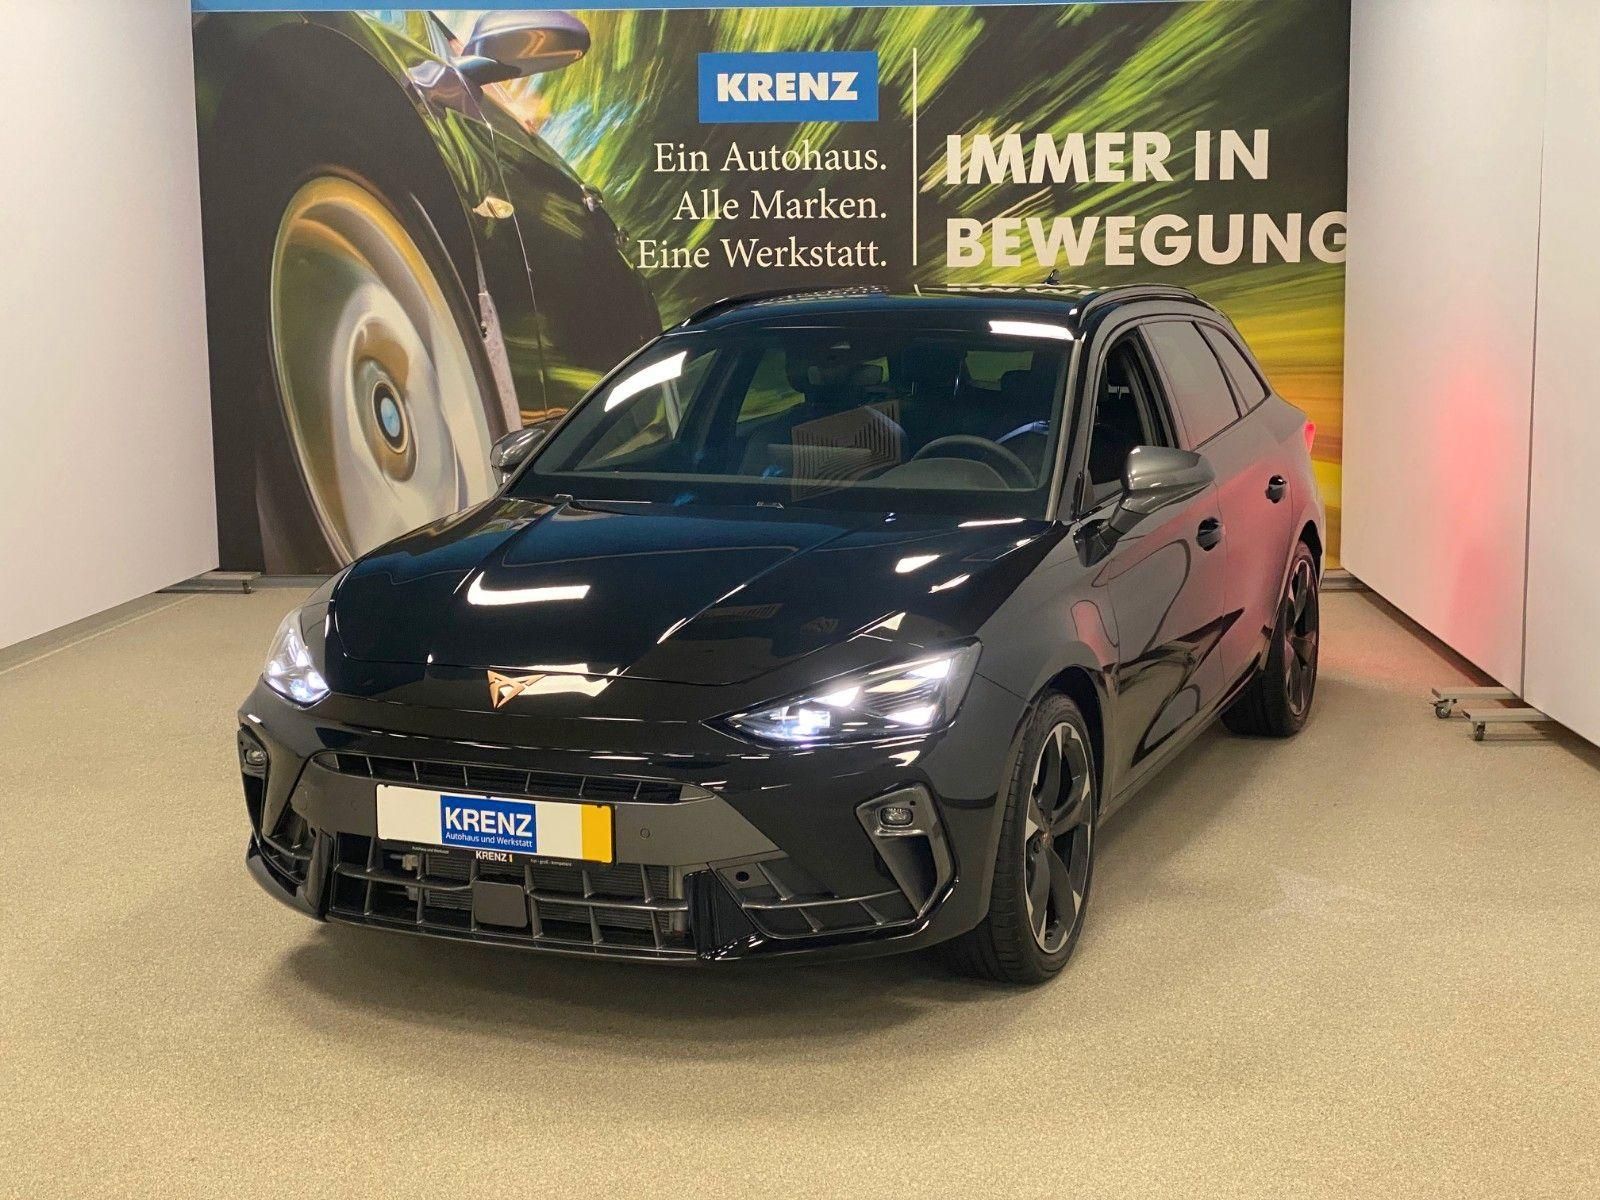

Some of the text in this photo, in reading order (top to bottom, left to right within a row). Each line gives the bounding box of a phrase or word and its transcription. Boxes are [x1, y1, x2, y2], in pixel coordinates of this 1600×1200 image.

[717, 72, 858, 101] KRENZ
[654, 140, 887, 172] Ein Autohaus.
[946, 129, 1269, 184] IMMER IN
[673, 187, 887, 220] Alle Marken.
[637, 236, 887, 269] Eine Werkstatt.
[946, 211, 1347, 267] BEWEGUNG
[445, 806, 533, 838] KRENZ
[445, 831, 533, 848] Autohaus und Werkstatt
[475, 850, 508, 863] KRENZ
